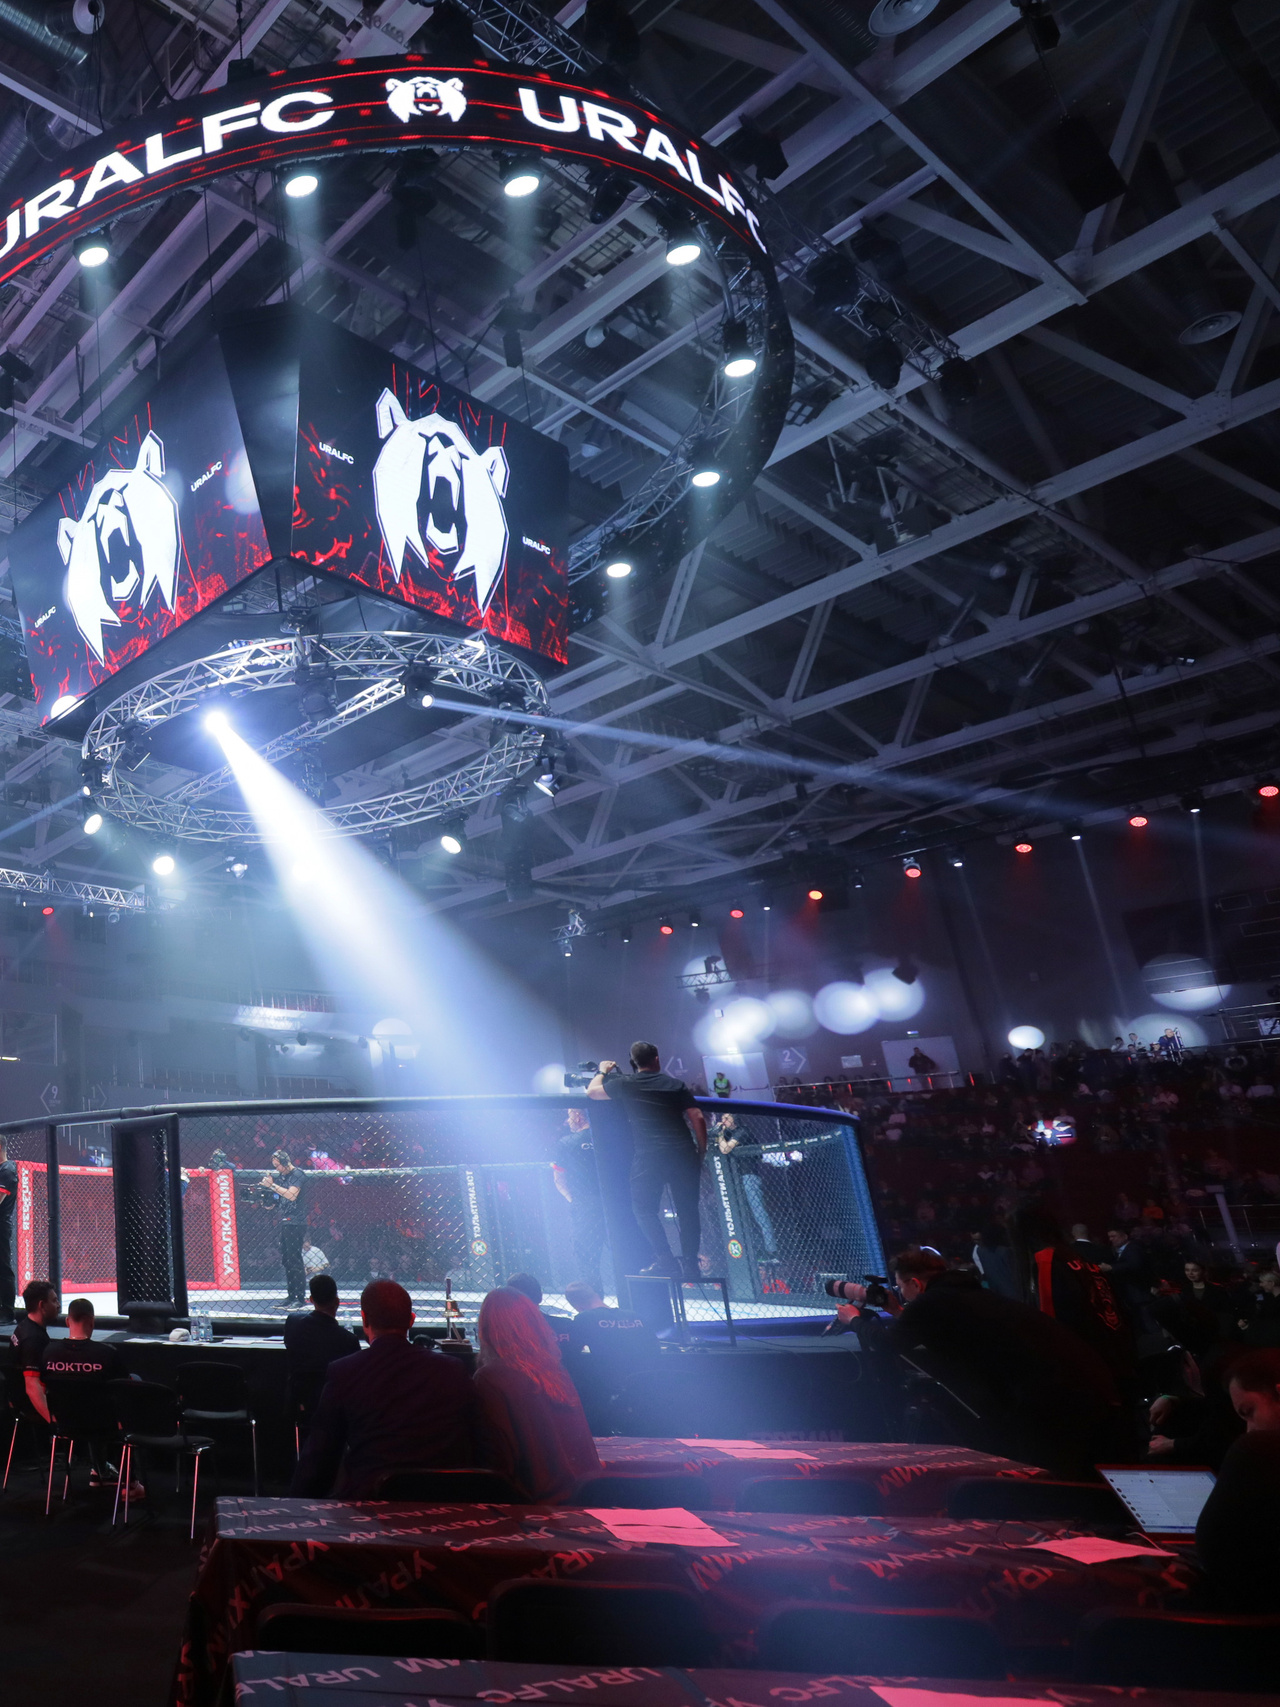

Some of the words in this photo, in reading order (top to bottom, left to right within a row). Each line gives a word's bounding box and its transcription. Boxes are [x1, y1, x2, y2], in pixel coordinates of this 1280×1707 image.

[518, 86, 767, 254] URALFC
[318, 441, 355, 465] URALFC
[190, 460, 223, 493] URALFC
[522, 535, 551, 555] URALFC
[34, 606, 57, 629] URALFC
[782, 1050, 792, 1062] 2
[51, 1085, 58, 1099] 9
[465, 1170, 481, 1238] ТОЛЬЯТТИАЗОТ
[713, 1156, 736, 1237] ТОЛЬЯТТИАЗОТ
[219, 1174, 235, 1276] УРАЛКАЛИЙ
[598, 1319, 644, 1329] СУДЬЯ
[46, 1361, 103, 1372] ДОКТОР
[476, 1666, 663, 1703] URALFC
